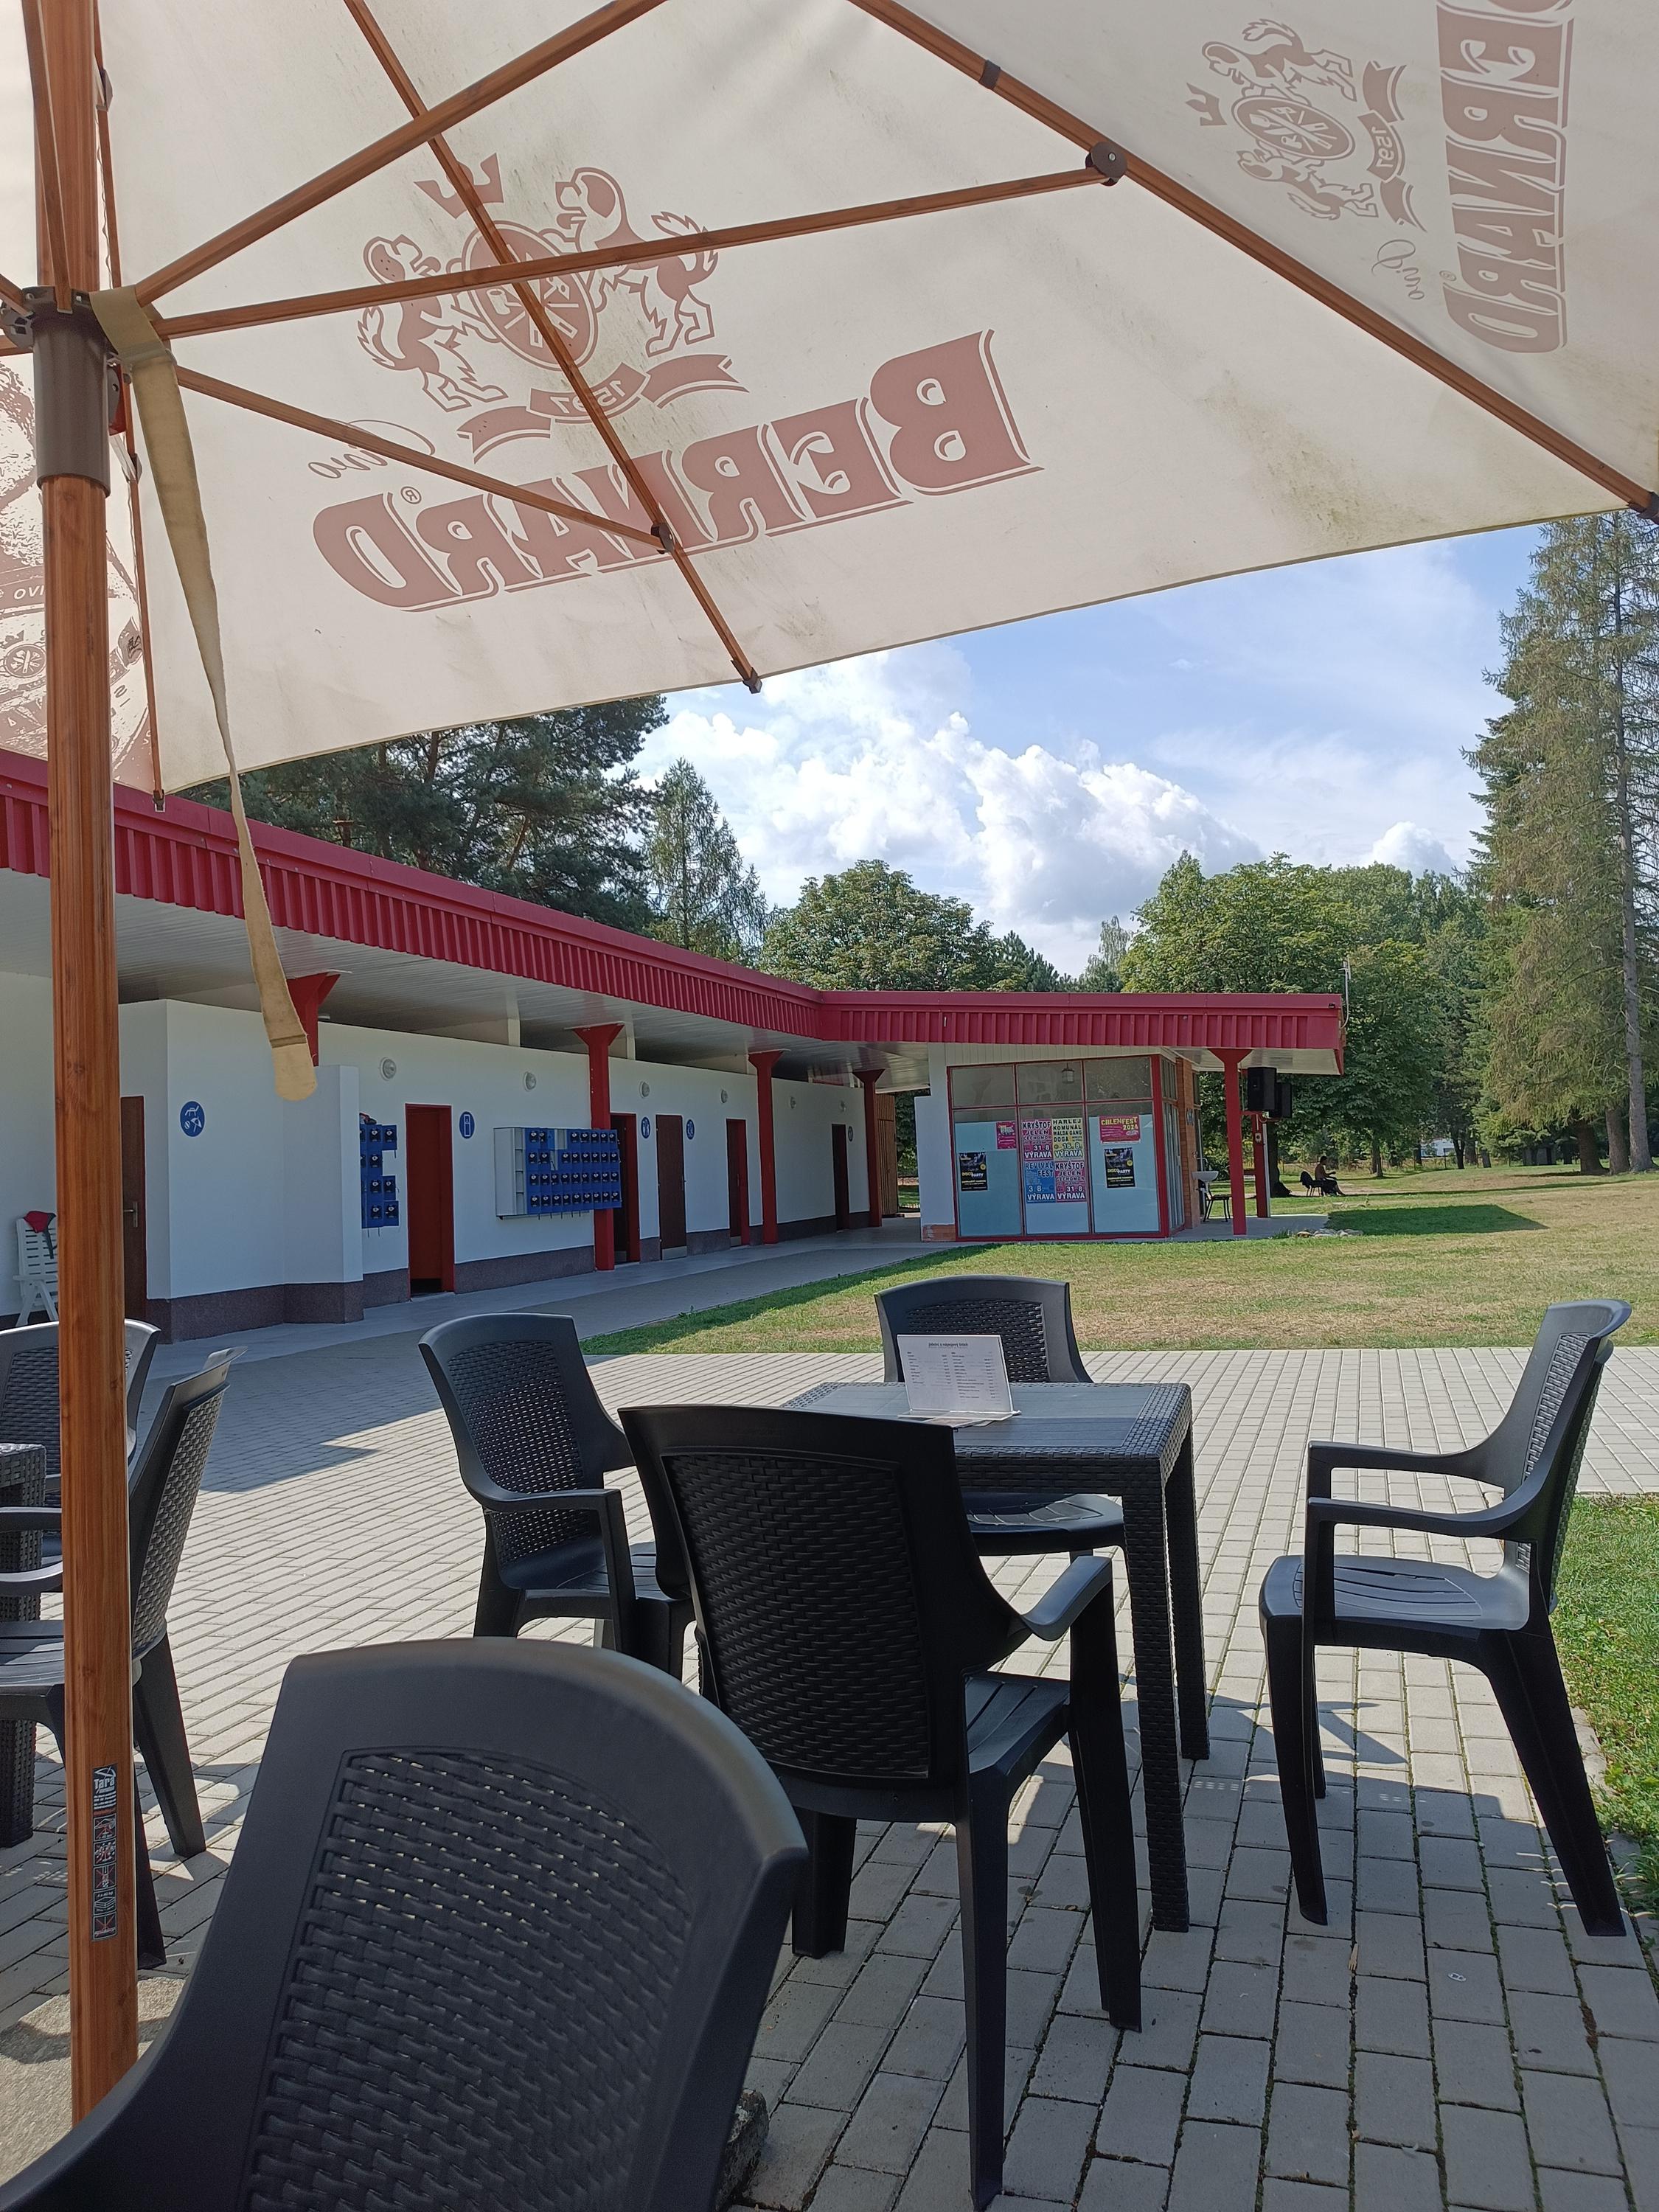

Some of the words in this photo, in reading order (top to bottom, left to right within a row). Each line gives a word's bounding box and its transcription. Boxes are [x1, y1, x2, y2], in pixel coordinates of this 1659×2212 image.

[1023, 1119, 1051, 1130] KRYŠTOF
[1024, 1150, 1052, 1158] VÝRAVA
[1054, 1149, 1083, 1158] VÝRAVA
[1055, 1161, 1084, 1170] KRYŠTOF
[1037, 1169, 1053, 1178] FEST
[1027, 1192, 1055, 1200] VÝRAVA
[1057, 1192, 1085, 1200] VÝRAVA
[94, 1776, 115, 1790] Tara
